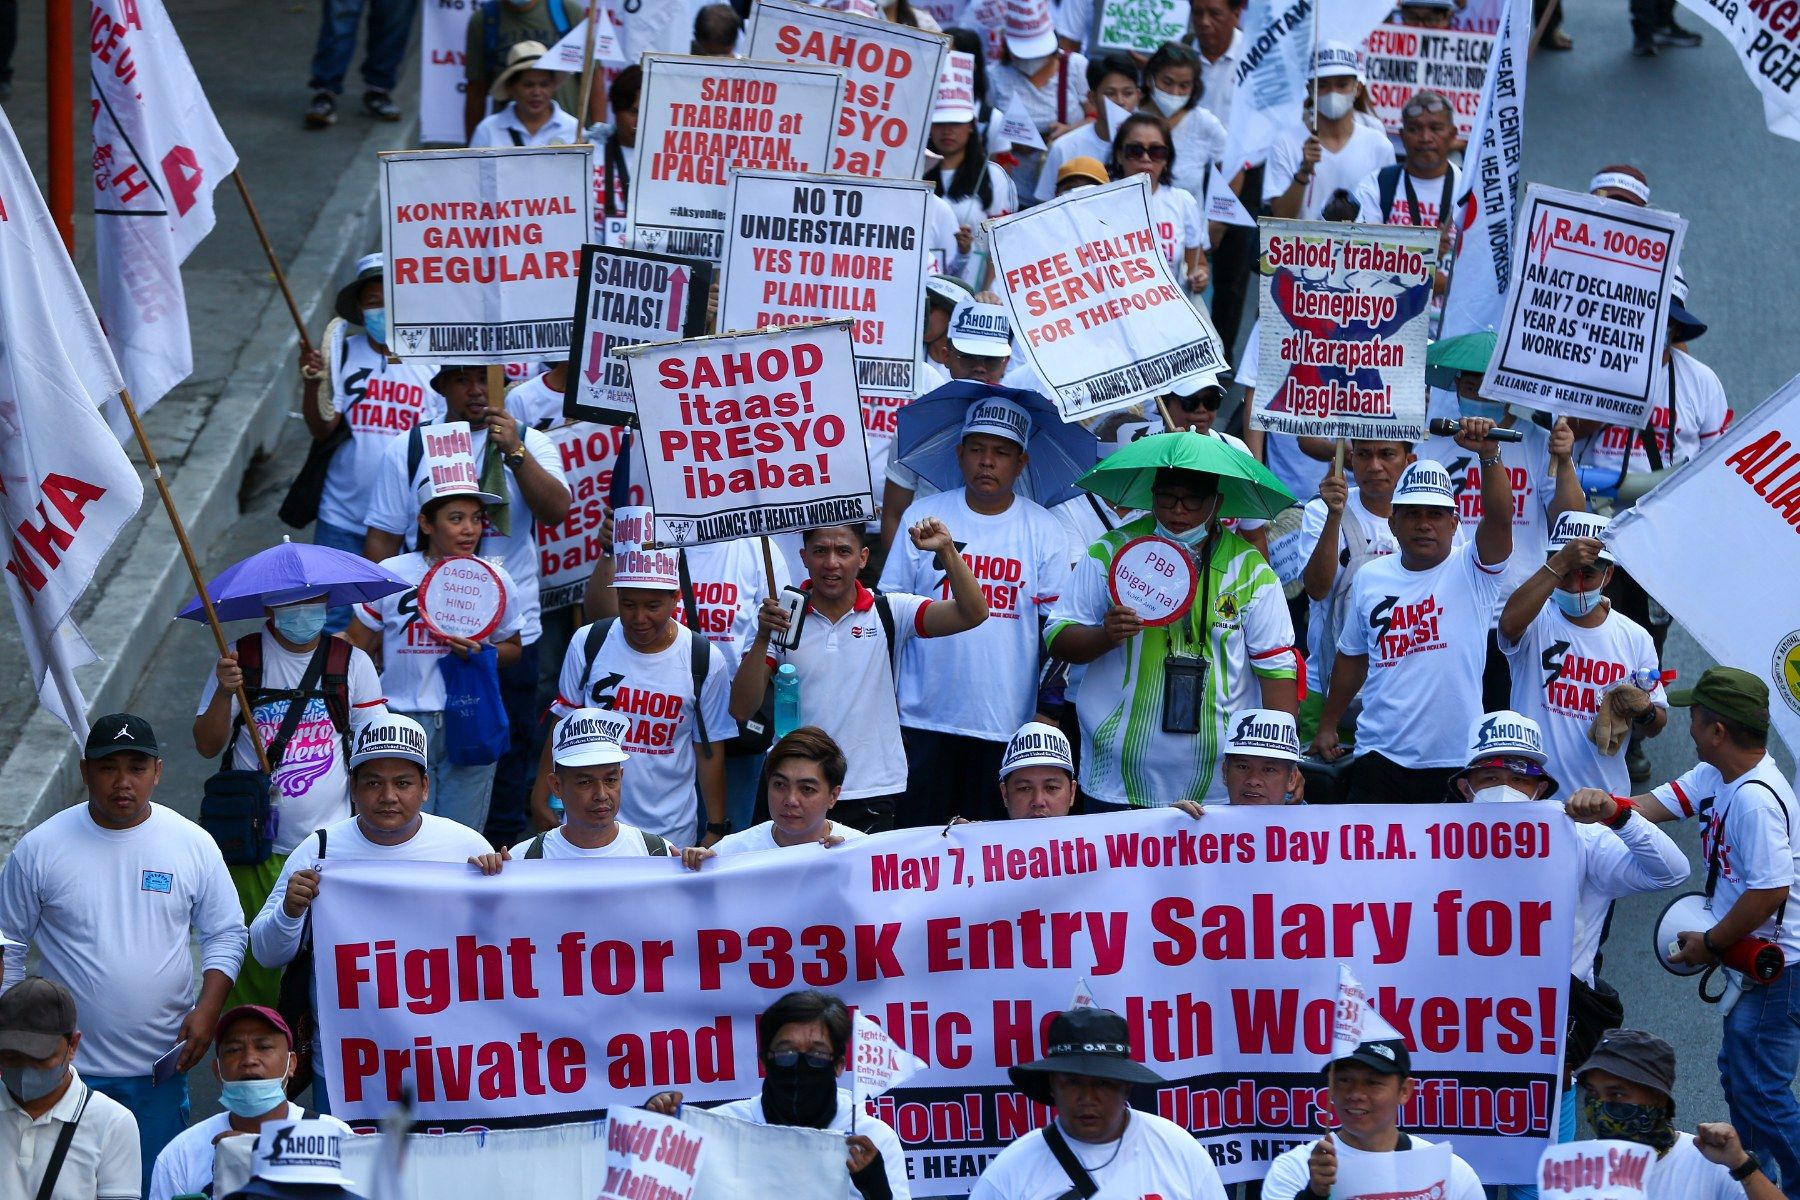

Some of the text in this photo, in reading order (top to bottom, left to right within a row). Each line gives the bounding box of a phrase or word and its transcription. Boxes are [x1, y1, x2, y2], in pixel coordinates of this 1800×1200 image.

[775, 24, 913, 80] SAHOD
[700, 77, 777, 105] SAHOD
[670, 103, 803, 135] TRABAHO at
[793, 186, 863, 218] NO TO
[1481, 155, 1506, 216] HEALTH
[397, 196, 577, 223] KONTRAKTWAL
[423, 223, 543, 249] GAWING
[740, 214, 915, 251] UNDERSTAFFING
[1554, 218, 1666, 263] R.A. 10069
[395, 249, 582, 285] REGULAR!
[594, 256, 669, 294] SAHOD
[753, 247, 894, 282] YES TO MORE
[1006, 253, 1073, 294] FREE
[1075, 228, 1154, 268] HEALTH
[1269, 236, 1427, 282] Sahod, trabaho,
[762, 280, 877, 313] PLANTILLA
[1025, 257, 1156, 317] SERVICES
[1295, 284, 1395, 326] benepisyo
[1526, 263, 1549, 285] AN
[1550, 268, 1575, 290] ACT
[1576, 274, 1658, 310] DECLARING
[591, 289, 664, 330] ITAAS!
[1530, 287, 1646, 331] MAY 7 OF EVERY
[429, 324, 534, 352] ALLIANCE OF HEALTH
[1027, 318, 1075, 348] FOR
[1522, 308, 1645, 353] YEAR AS "HEALTH
[658, 343, 824, 390] SAHOD
[1085, 370, 1130, 404] ALLIANCE
[1129, 366, 1143, 392] OF
[1170, 342, 1215, 380] WORKERS
[1280, 333, 1404, 373] at karapatan
[1521, 331, 1639, 374] WORKERS' DAY"
[858, 360, 911, 389] WORKERS
[678, 380, 815, 426] itaas!
[1287, 378, 1392, 418] Ipaglaban!
[1493, 374, 1645, 417] ALLIANCE OF HEALTH WORKERS
[660, 414, 846, 462] PRESYO
[1276, 418, 1421, 440] ALLIANCE OF HEALTH WORKERS
[683, 453, 831, 499] ibaba!
[697, 498, 864, 543] ALLIANCE OF HEALTH WORKERS
[443, 566, 489, 583] DAGDAG
[1145, 551, 1176, 578] PBB
[443, 581, 483, 599] SAHOD,
[446, 597, 476, 612] HINDI
[1116, 564, 1180, 612] Ibigay na!
[435, 611, 482, 628] CHA-CHA
[872, 853, 940, 892] May
[947, 847, 974, 888] 7,
[982, 836, 1098, 882] Health
[1104, 829, 1256, 868] Workers
[1265, 825, 1330, 865] Day
[335, 889, 1552, 1015] Fight for P33K Entry Salary for
[341, 1031, 587, 1103] Private
[607, 1016, 737, 1089] and
